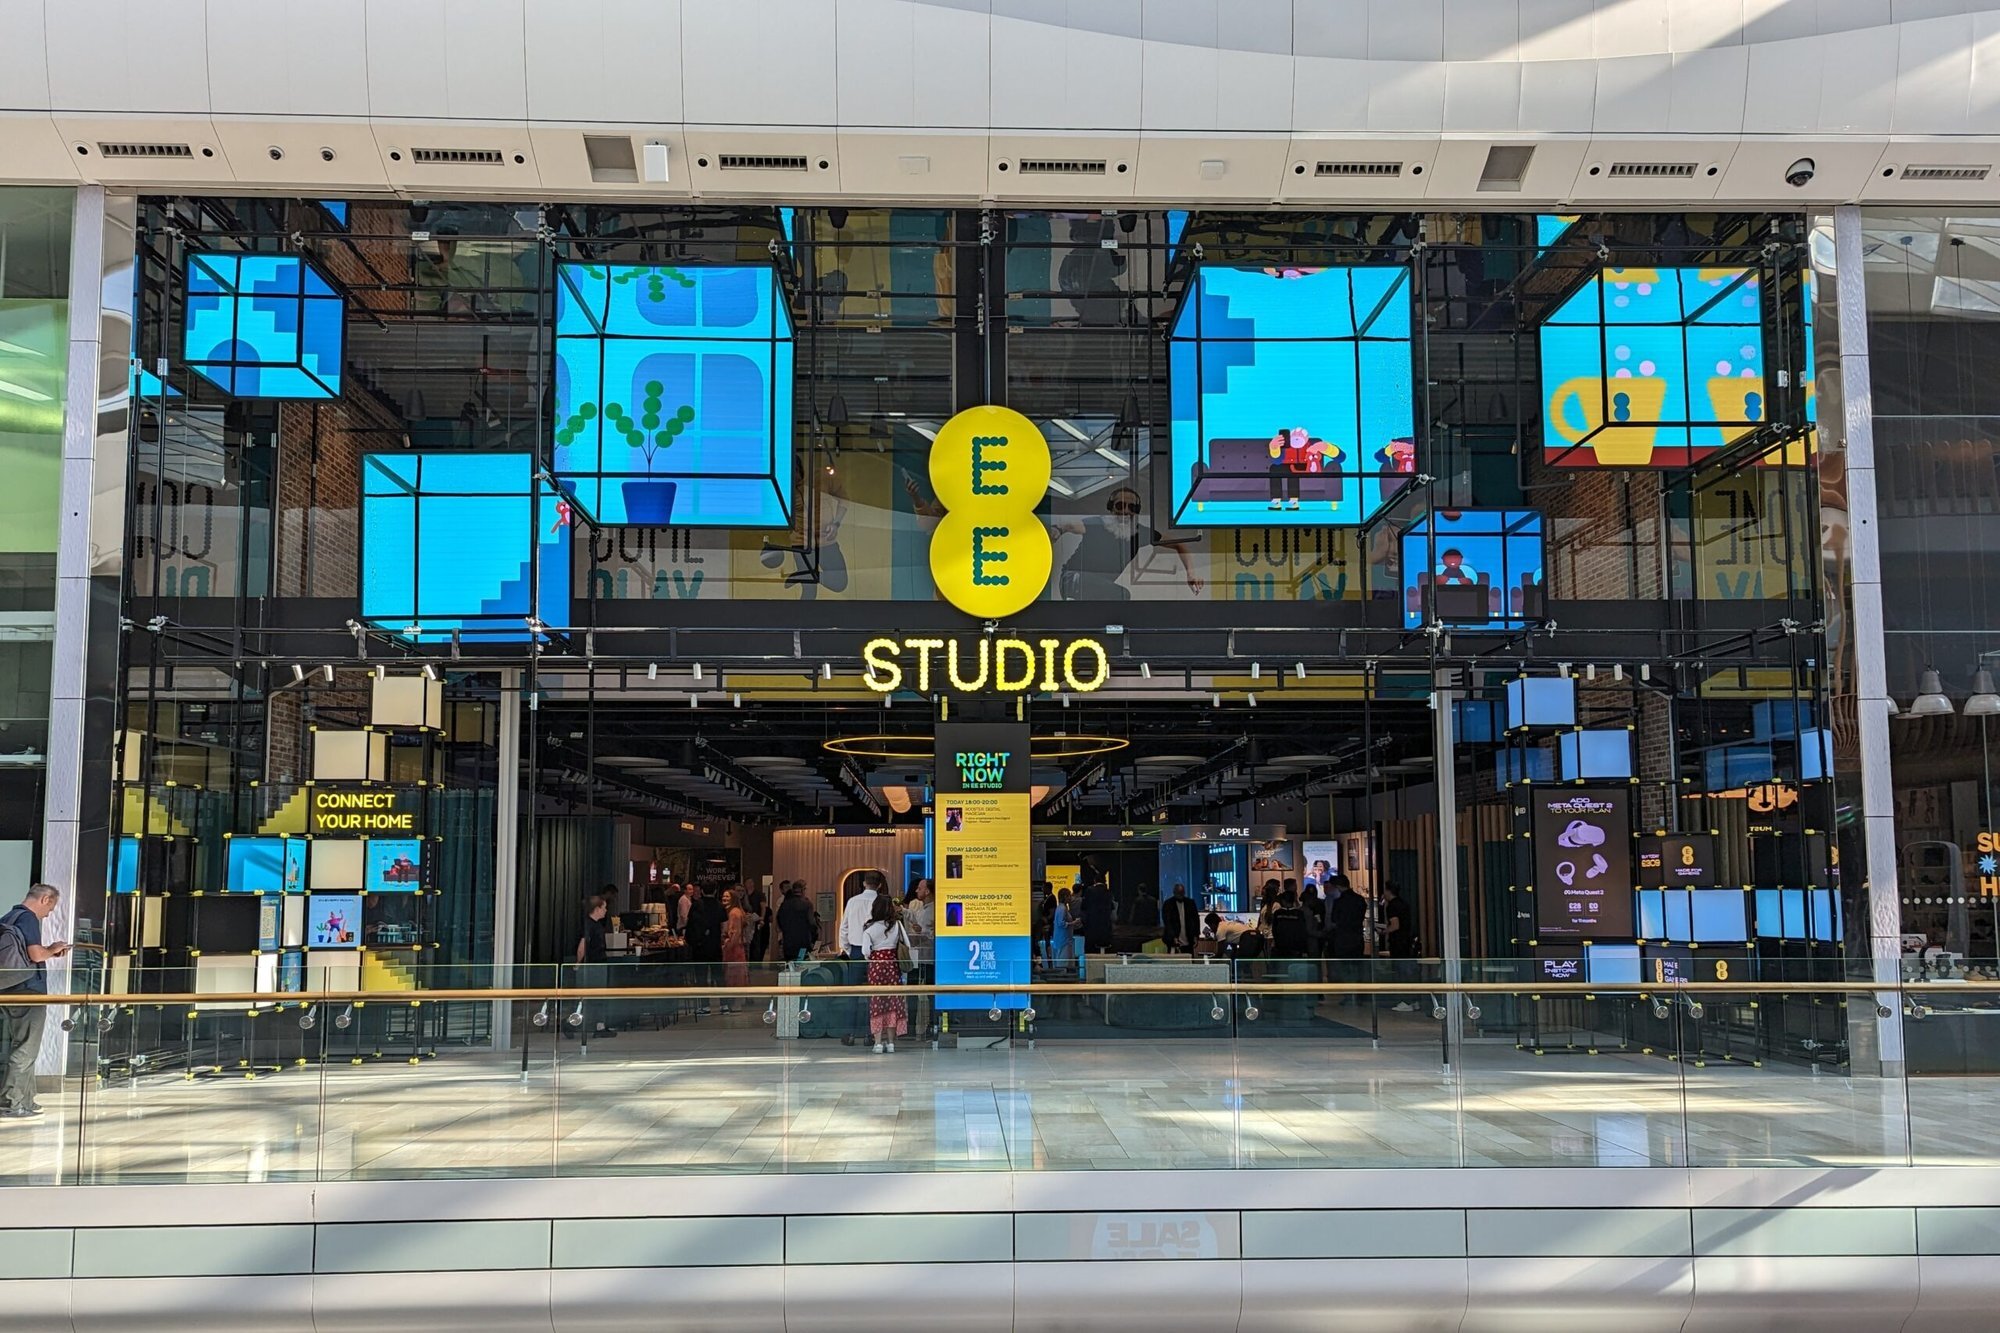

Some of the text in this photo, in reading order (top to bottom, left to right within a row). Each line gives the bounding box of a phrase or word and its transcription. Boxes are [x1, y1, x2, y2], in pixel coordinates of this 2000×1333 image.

[862, 638, 1108, 692] STUDIO
[955, 752, 1011, 767] RIGHT
[962, 767, 1004, 782] NOW
[316, 793, 396, 808] CONNECT
[316, 814, 413, 828] YOUR HOME
[1219, 827, 1250, 837] APPLE
[968, 940, 980, 970] 2
[1544, 960, 1578, 968] PLAY
